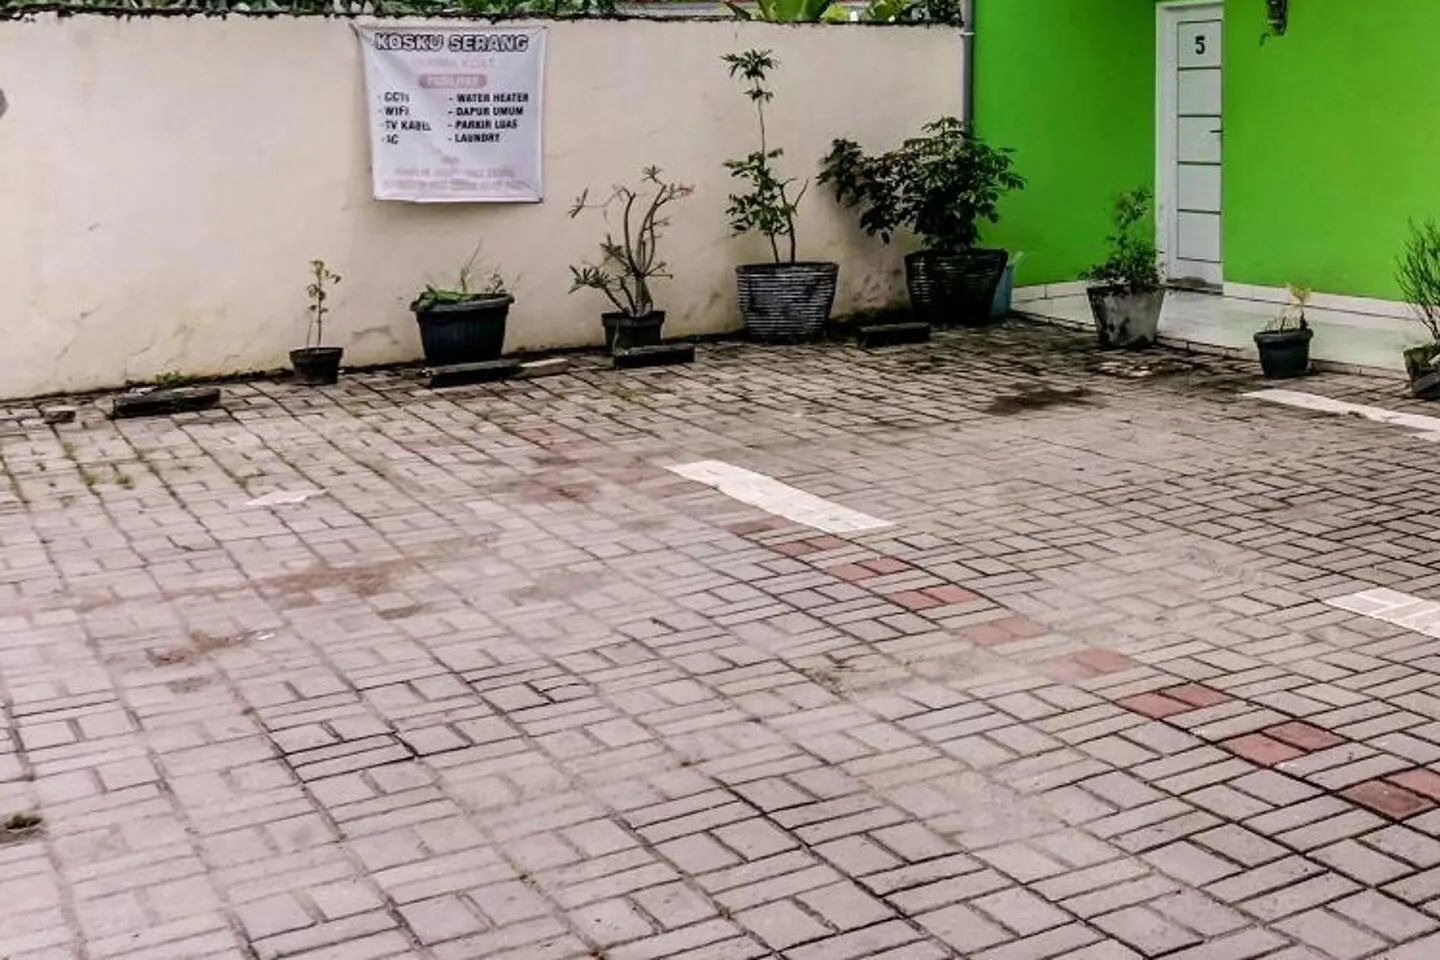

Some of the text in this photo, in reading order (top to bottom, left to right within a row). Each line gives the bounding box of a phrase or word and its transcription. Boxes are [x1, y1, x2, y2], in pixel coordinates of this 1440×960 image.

[375, 32, 529, 52] KOSKU SERANG
[1195, 35, 1205, 55] 5
[457, 92, 529, 102] WATER HEATER
[385, 105, 409, 116] WIFI
[456, 106, 523, 116] DAPUR UMUM
[385, 120, 398, 130] TV
[455, 119, 518, 129] PARKIR LUAS
